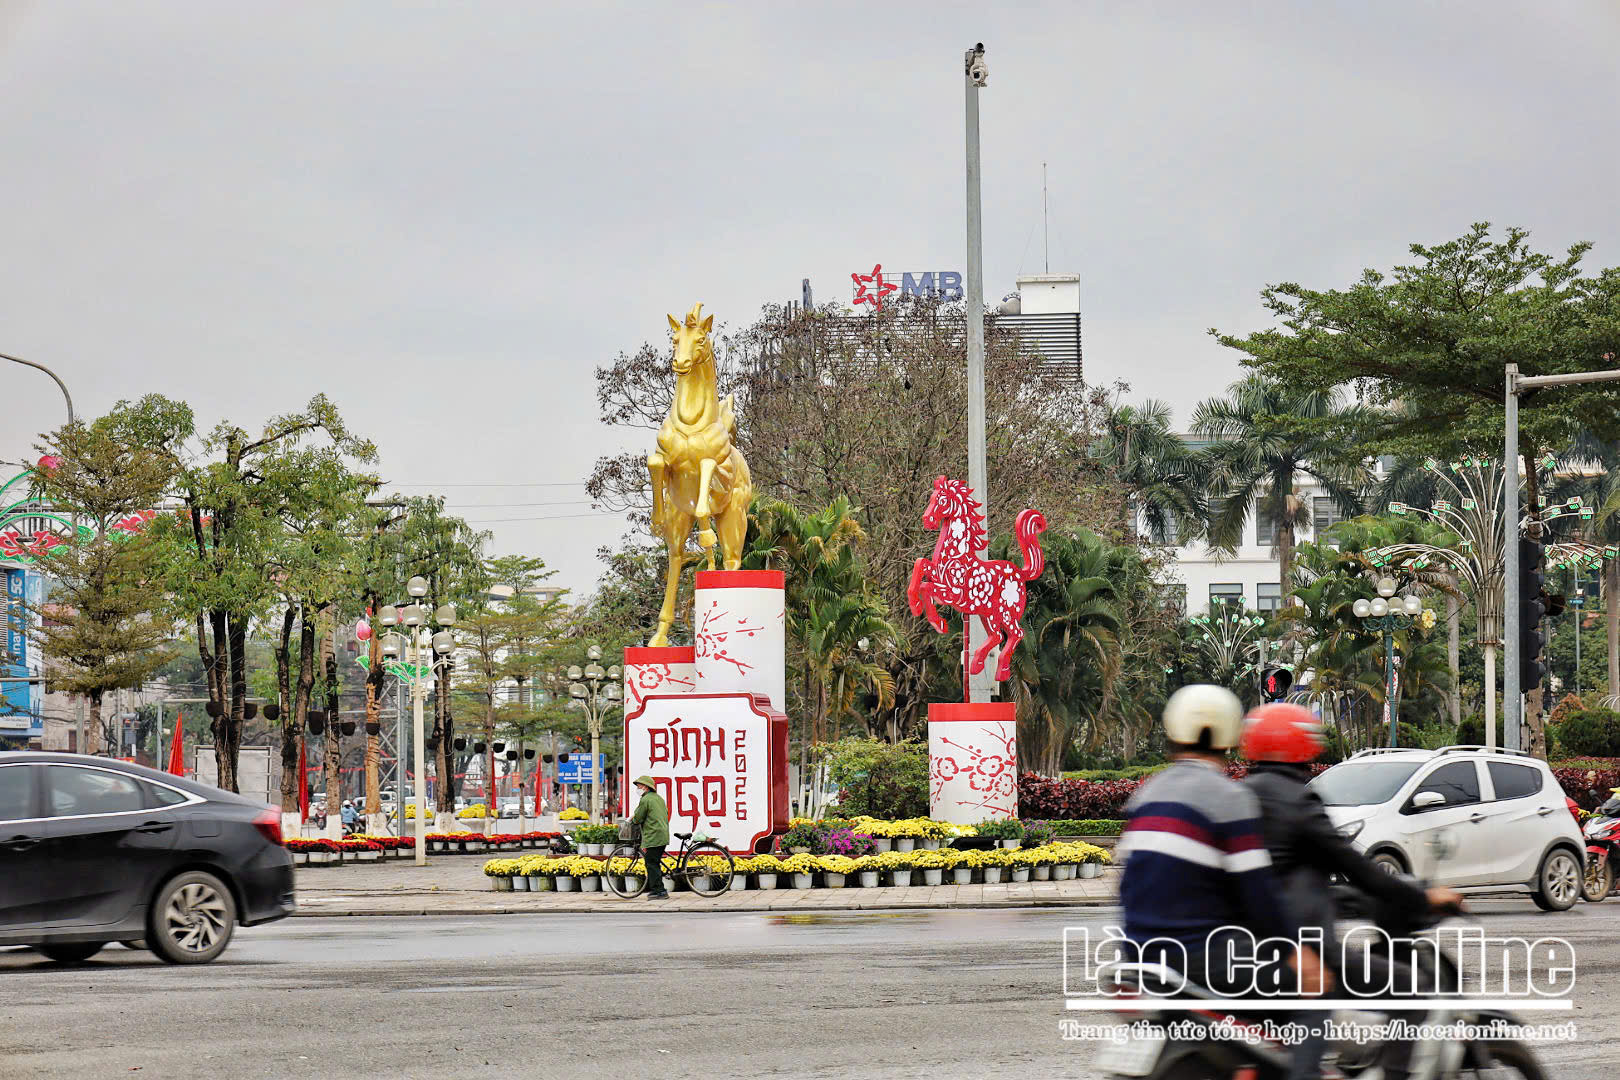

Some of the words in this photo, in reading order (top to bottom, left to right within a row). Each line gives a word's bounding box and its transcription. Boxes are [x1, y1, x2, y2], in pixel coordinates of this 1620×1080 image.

[902, 271, 963, 302] MB
[647, 717, 725, 768] BÍNH
[735, 729, 747, 820] 2026
